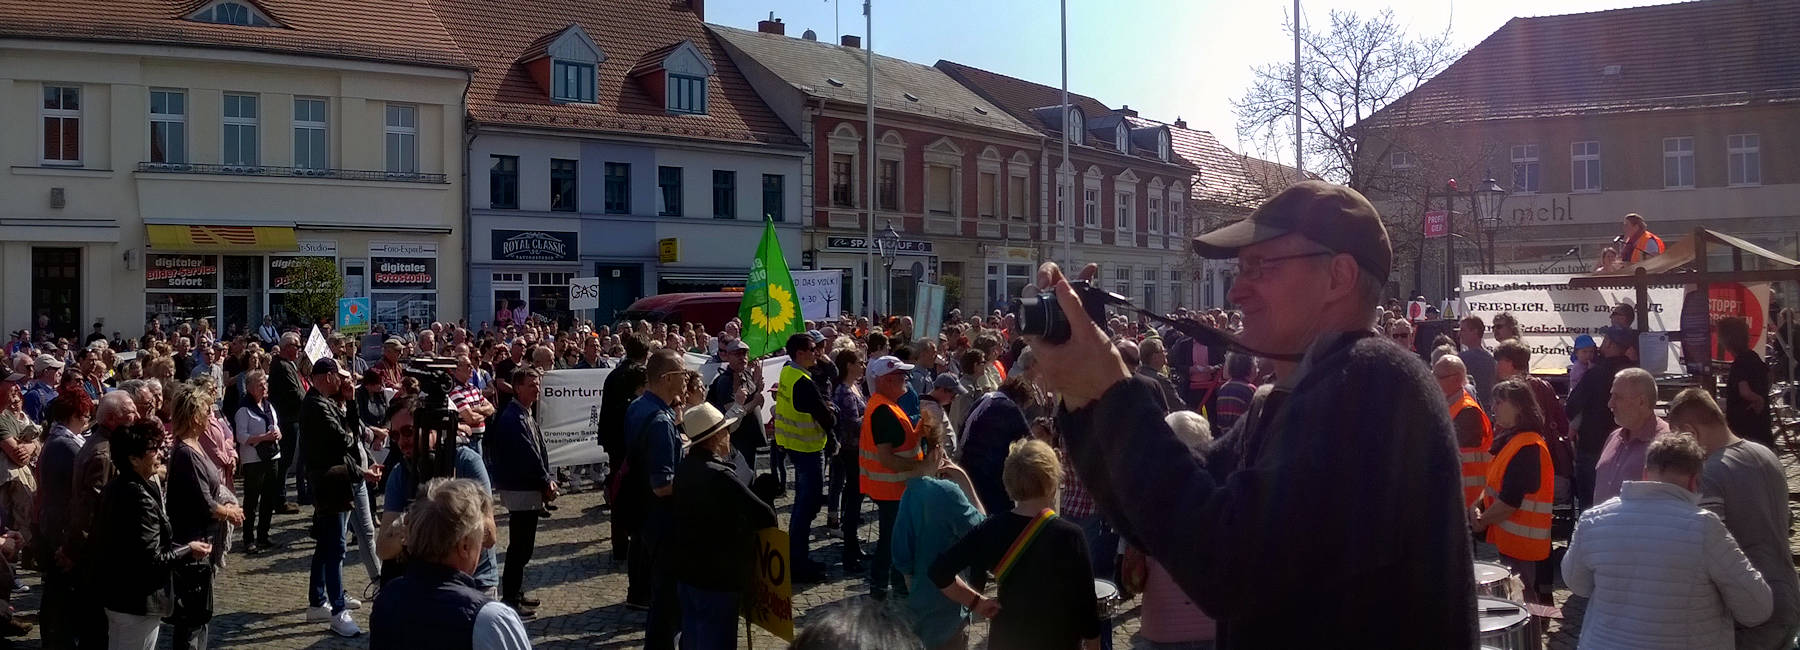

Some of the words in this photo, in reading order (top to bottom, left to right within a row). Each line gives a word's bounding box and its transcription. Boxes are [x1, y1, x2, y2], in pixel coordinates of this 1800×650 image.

[503, 239, 530, 254] ROYAL
[532, 239, 566, 255] CLASSIC
[155, 257, 202, 268] digitaler
[381, 263, 426, 273] digitales
[146, 265, 217, 281] Bilder-Service
[375, 273, 431, 283] Fotostudio
[168, 277, 203, 286] sofort
[802, 279, 816, 287] DAS
[571, 283, 599, 299] GAS
[1553, 303, 1590, 314] BUNT
